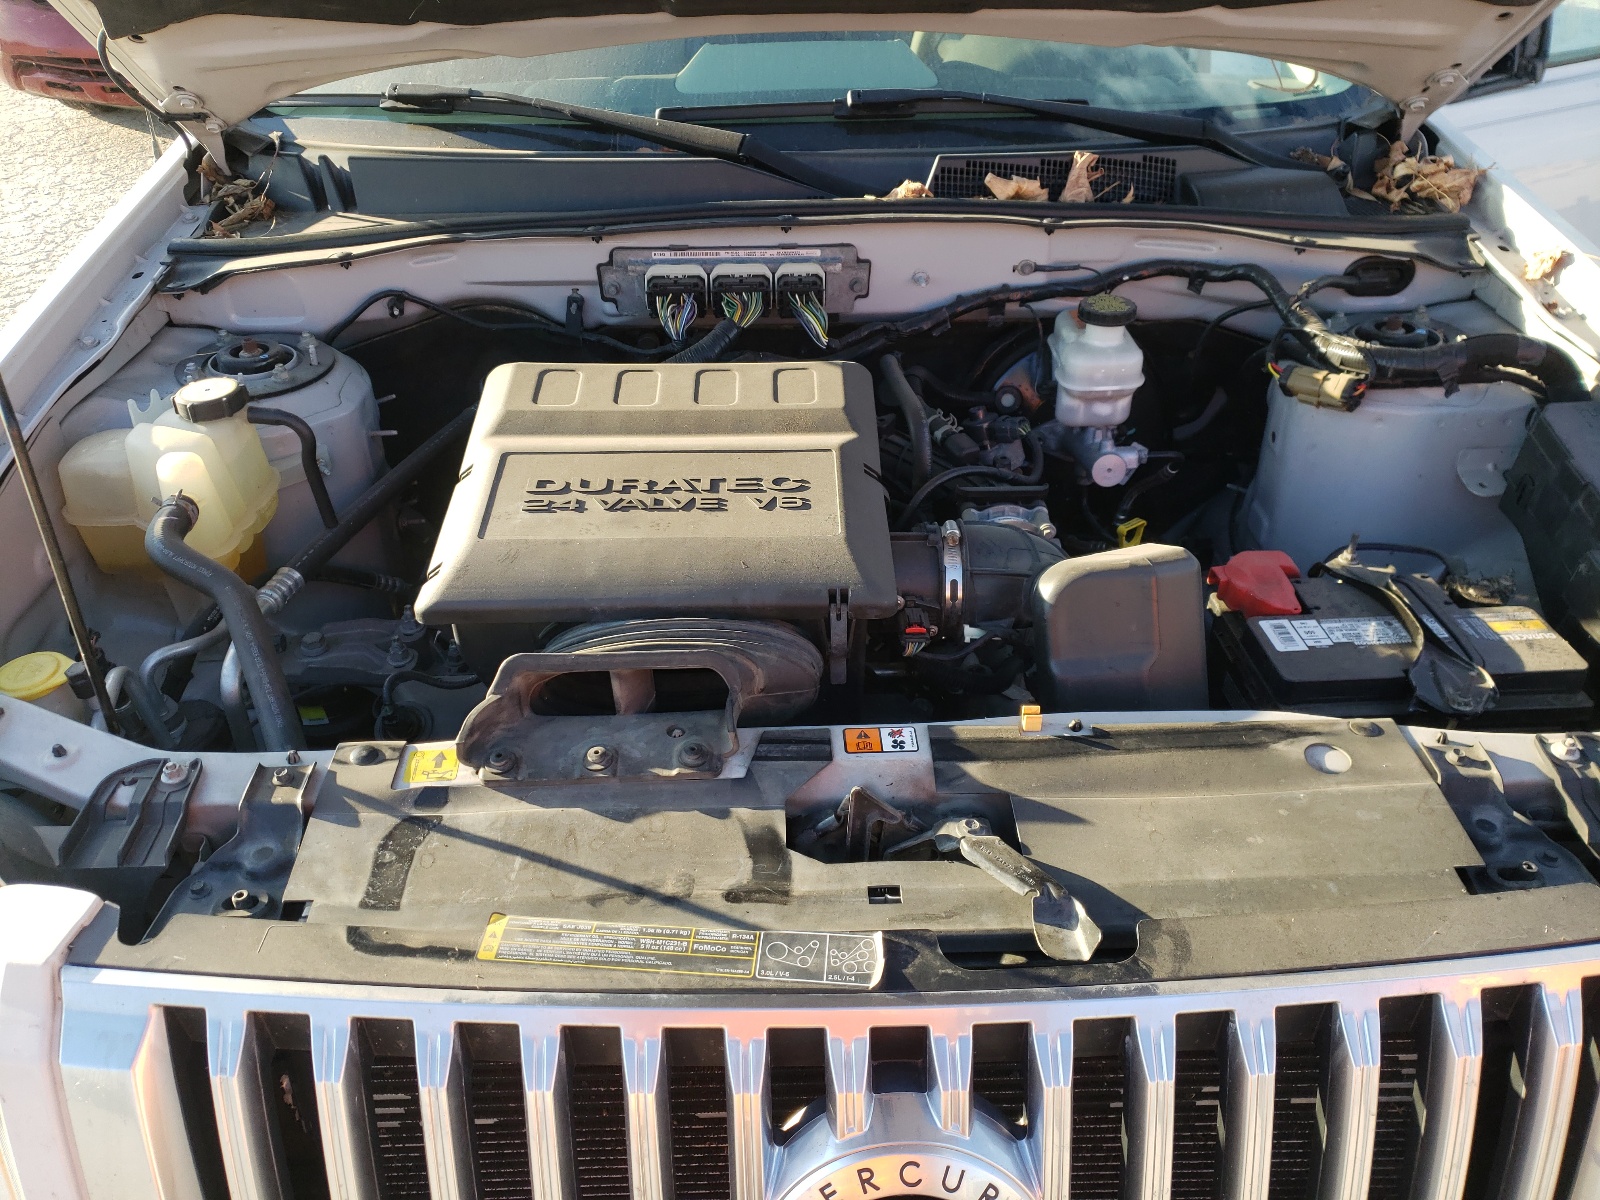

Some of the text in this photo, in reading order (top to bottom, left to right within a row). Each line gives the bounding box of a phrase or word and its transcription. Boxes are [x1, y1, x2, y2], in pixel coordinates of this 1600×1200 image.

[526, 477, 811, 494] DURATEC
[522, 495, 812, 513] 24 VALVE V6
[693, 943, 726, 952] FoMoCo
